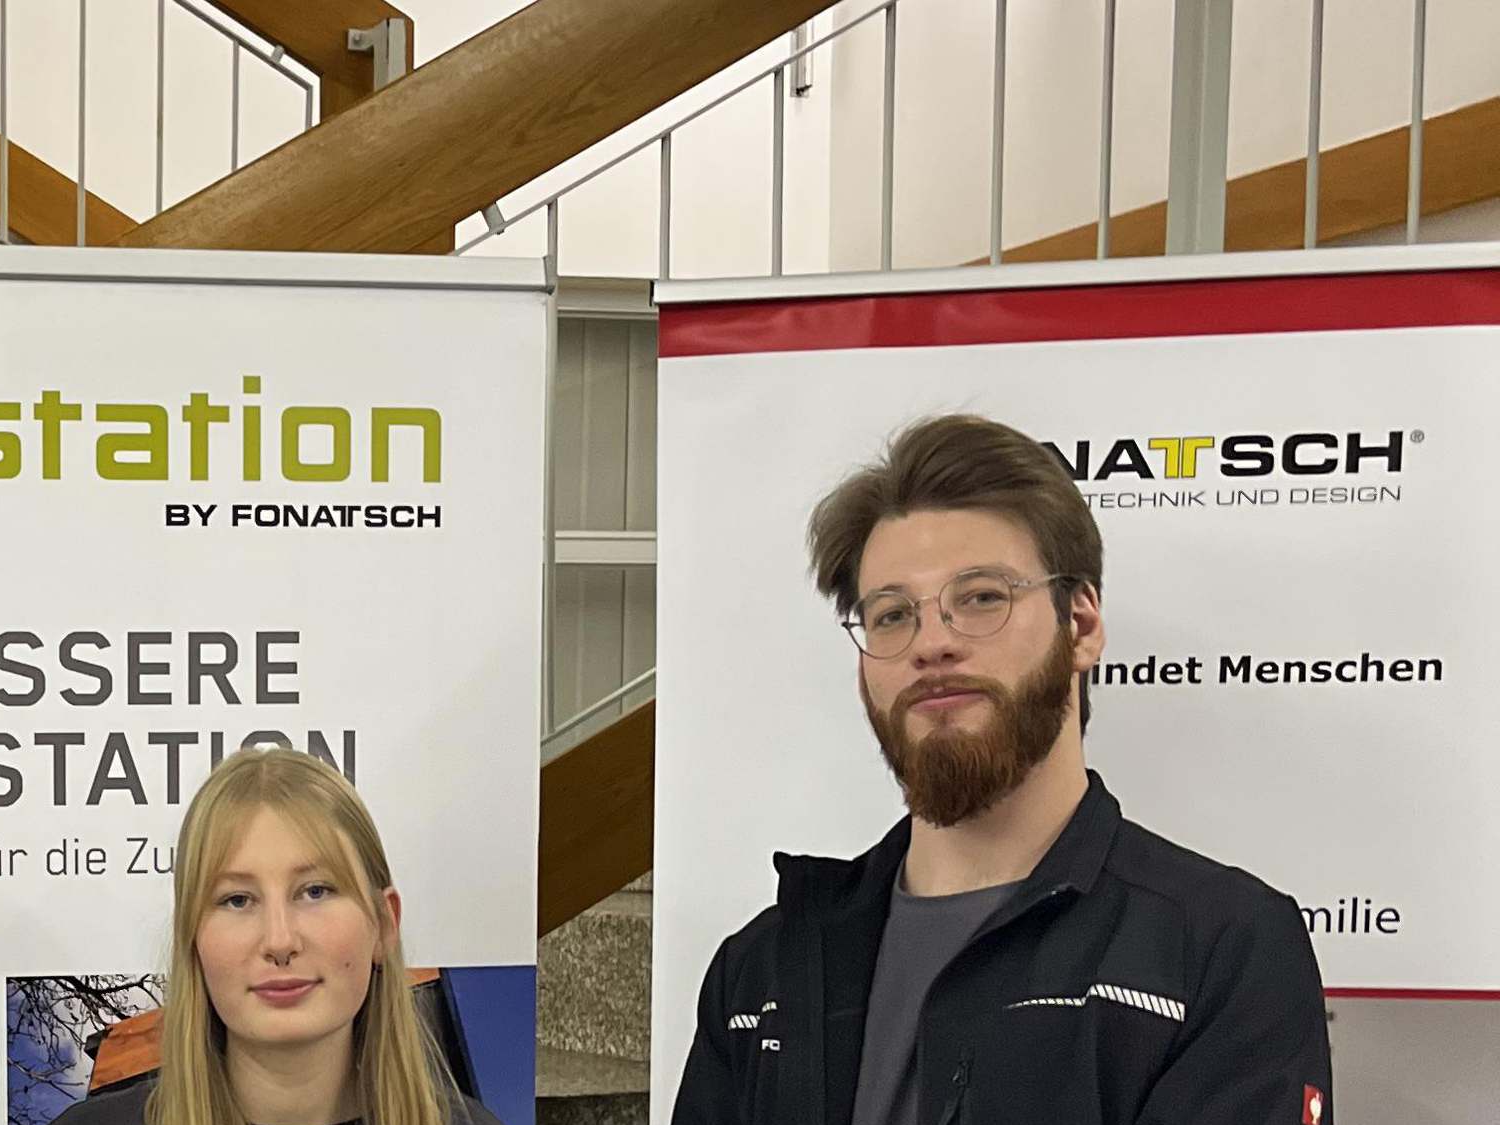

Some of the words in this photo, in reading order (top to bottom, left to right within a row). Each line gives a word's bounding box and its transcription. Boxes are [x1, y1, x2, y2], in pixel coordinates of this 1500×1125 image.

[1084, 490, 1206, 509] TECHNIK
[1216, 488, 1280, 506] UND
[1289, 485, 1402, 505] DESIGN
[165, 505, 217, 528] BY
[1091, 656, 1203, 685] indet
[1219, 652, 1443, 684] Menschen
[46, 838, 107, 876] die
[126, 837, 175, 875] Zu
[1299, 896, 1401, 934] milie
